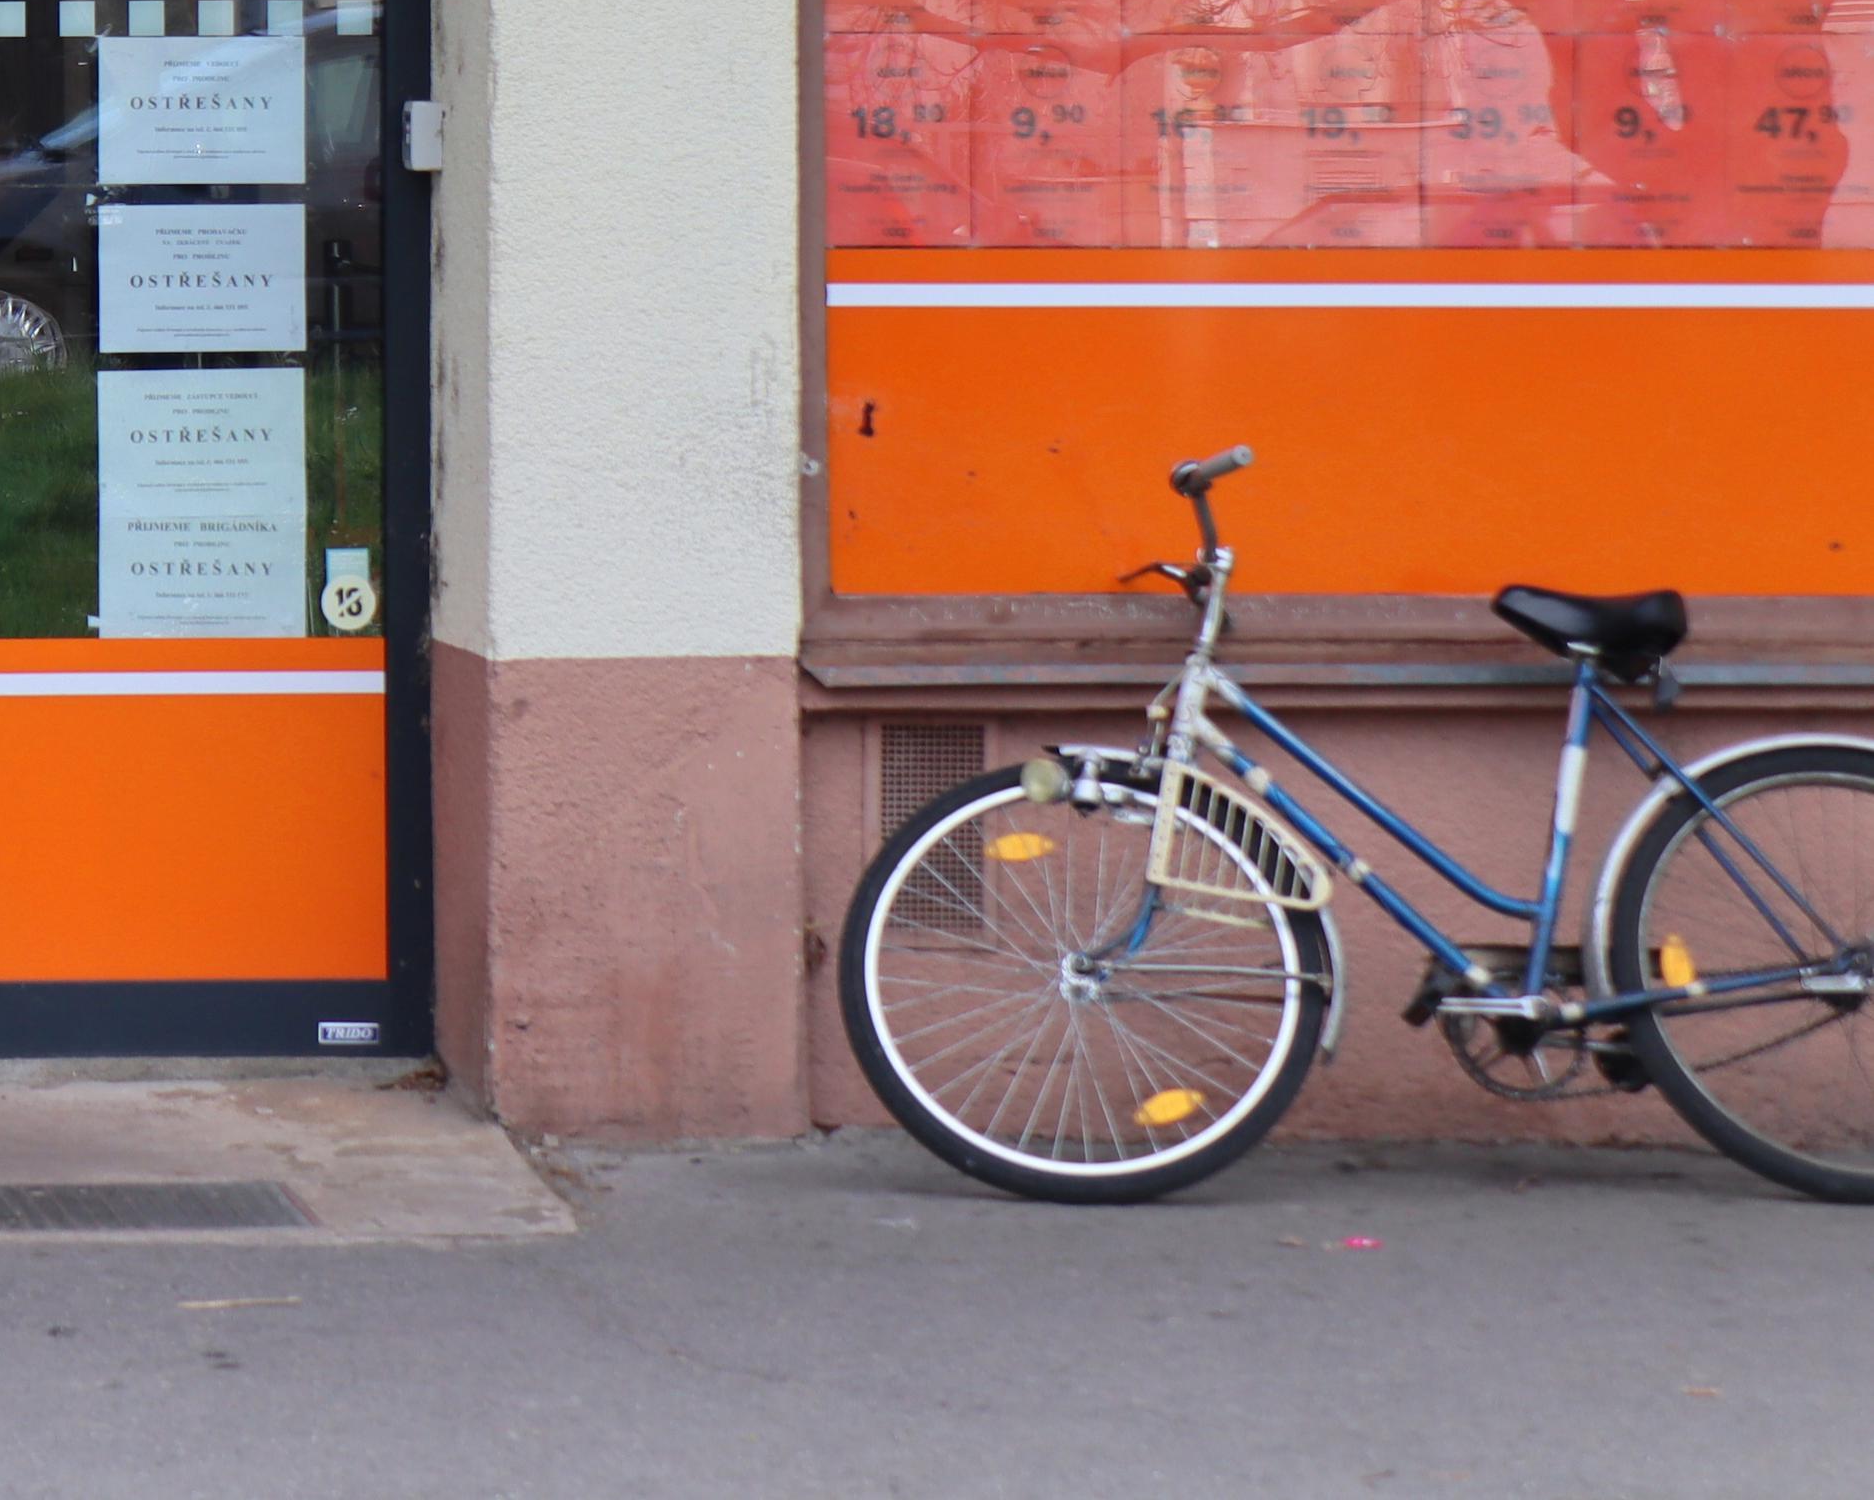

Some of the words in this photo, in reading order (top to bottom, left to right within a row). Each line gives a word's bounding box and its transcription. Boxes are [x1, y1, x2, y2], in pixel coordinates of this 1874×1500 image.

[130, 92, 272, 110] OSTŘEŠANY
[130, 271, 274, 288] OSTŘEŠANY
[130, 427, 273, 444] OSTŘEŠANY
[127, 521, 191, 532] PŘIJMEME
[199, 522, 278, 533] BRIGÁDNÍKA
[131, 560, 274, 576] OSTŘEŠANY
